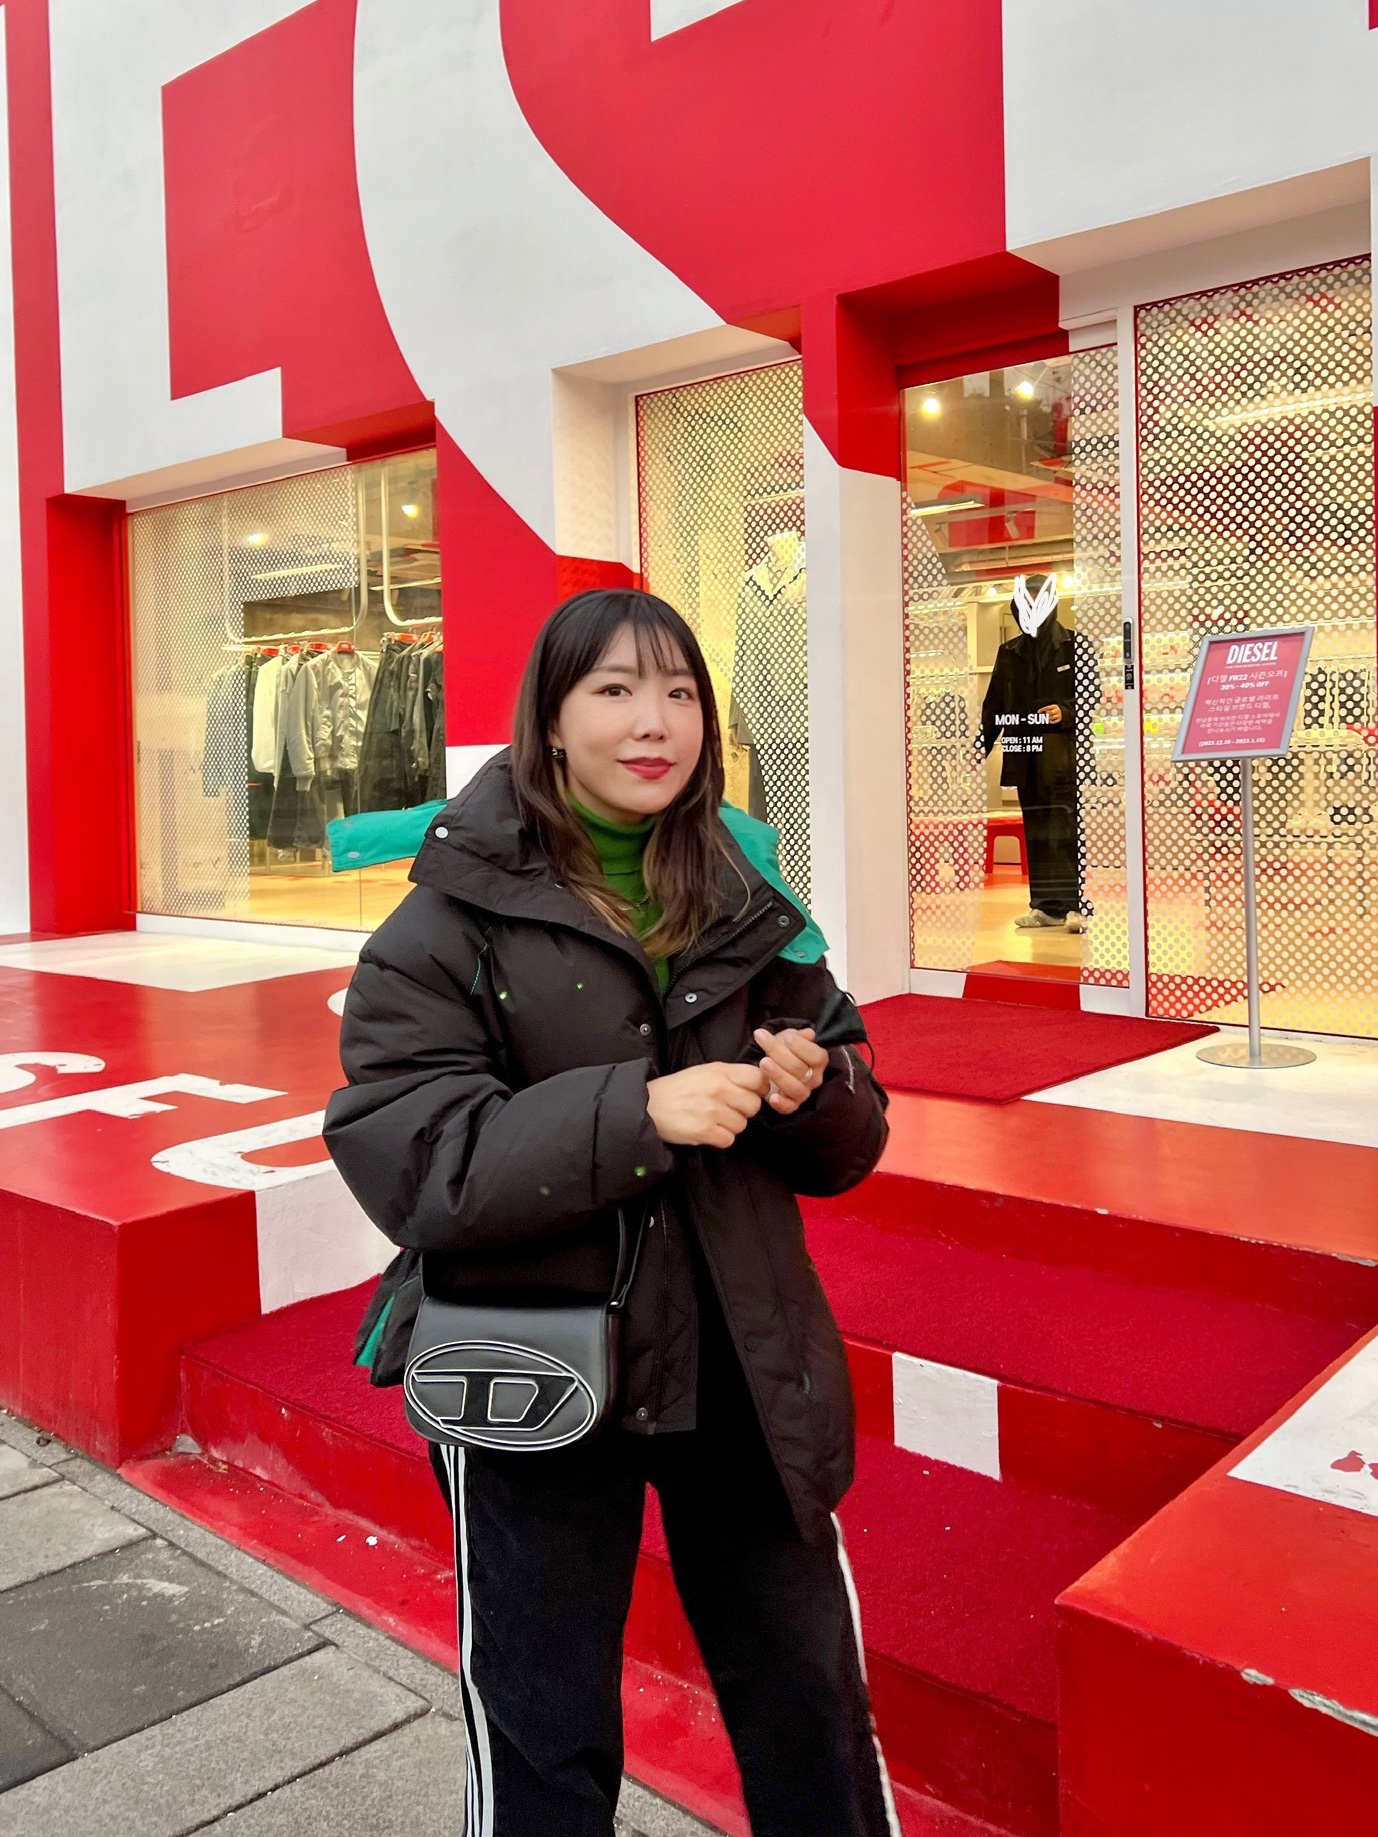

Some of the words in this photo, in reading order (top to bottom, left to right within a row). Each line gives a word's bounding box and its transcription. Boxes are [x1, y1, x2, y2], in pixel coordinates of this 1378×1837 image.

[1226, 641, 1278, 664] DIESEL
[995, 714, 1019, 726] MON
[1028, 714, 1050, 725] SUN
